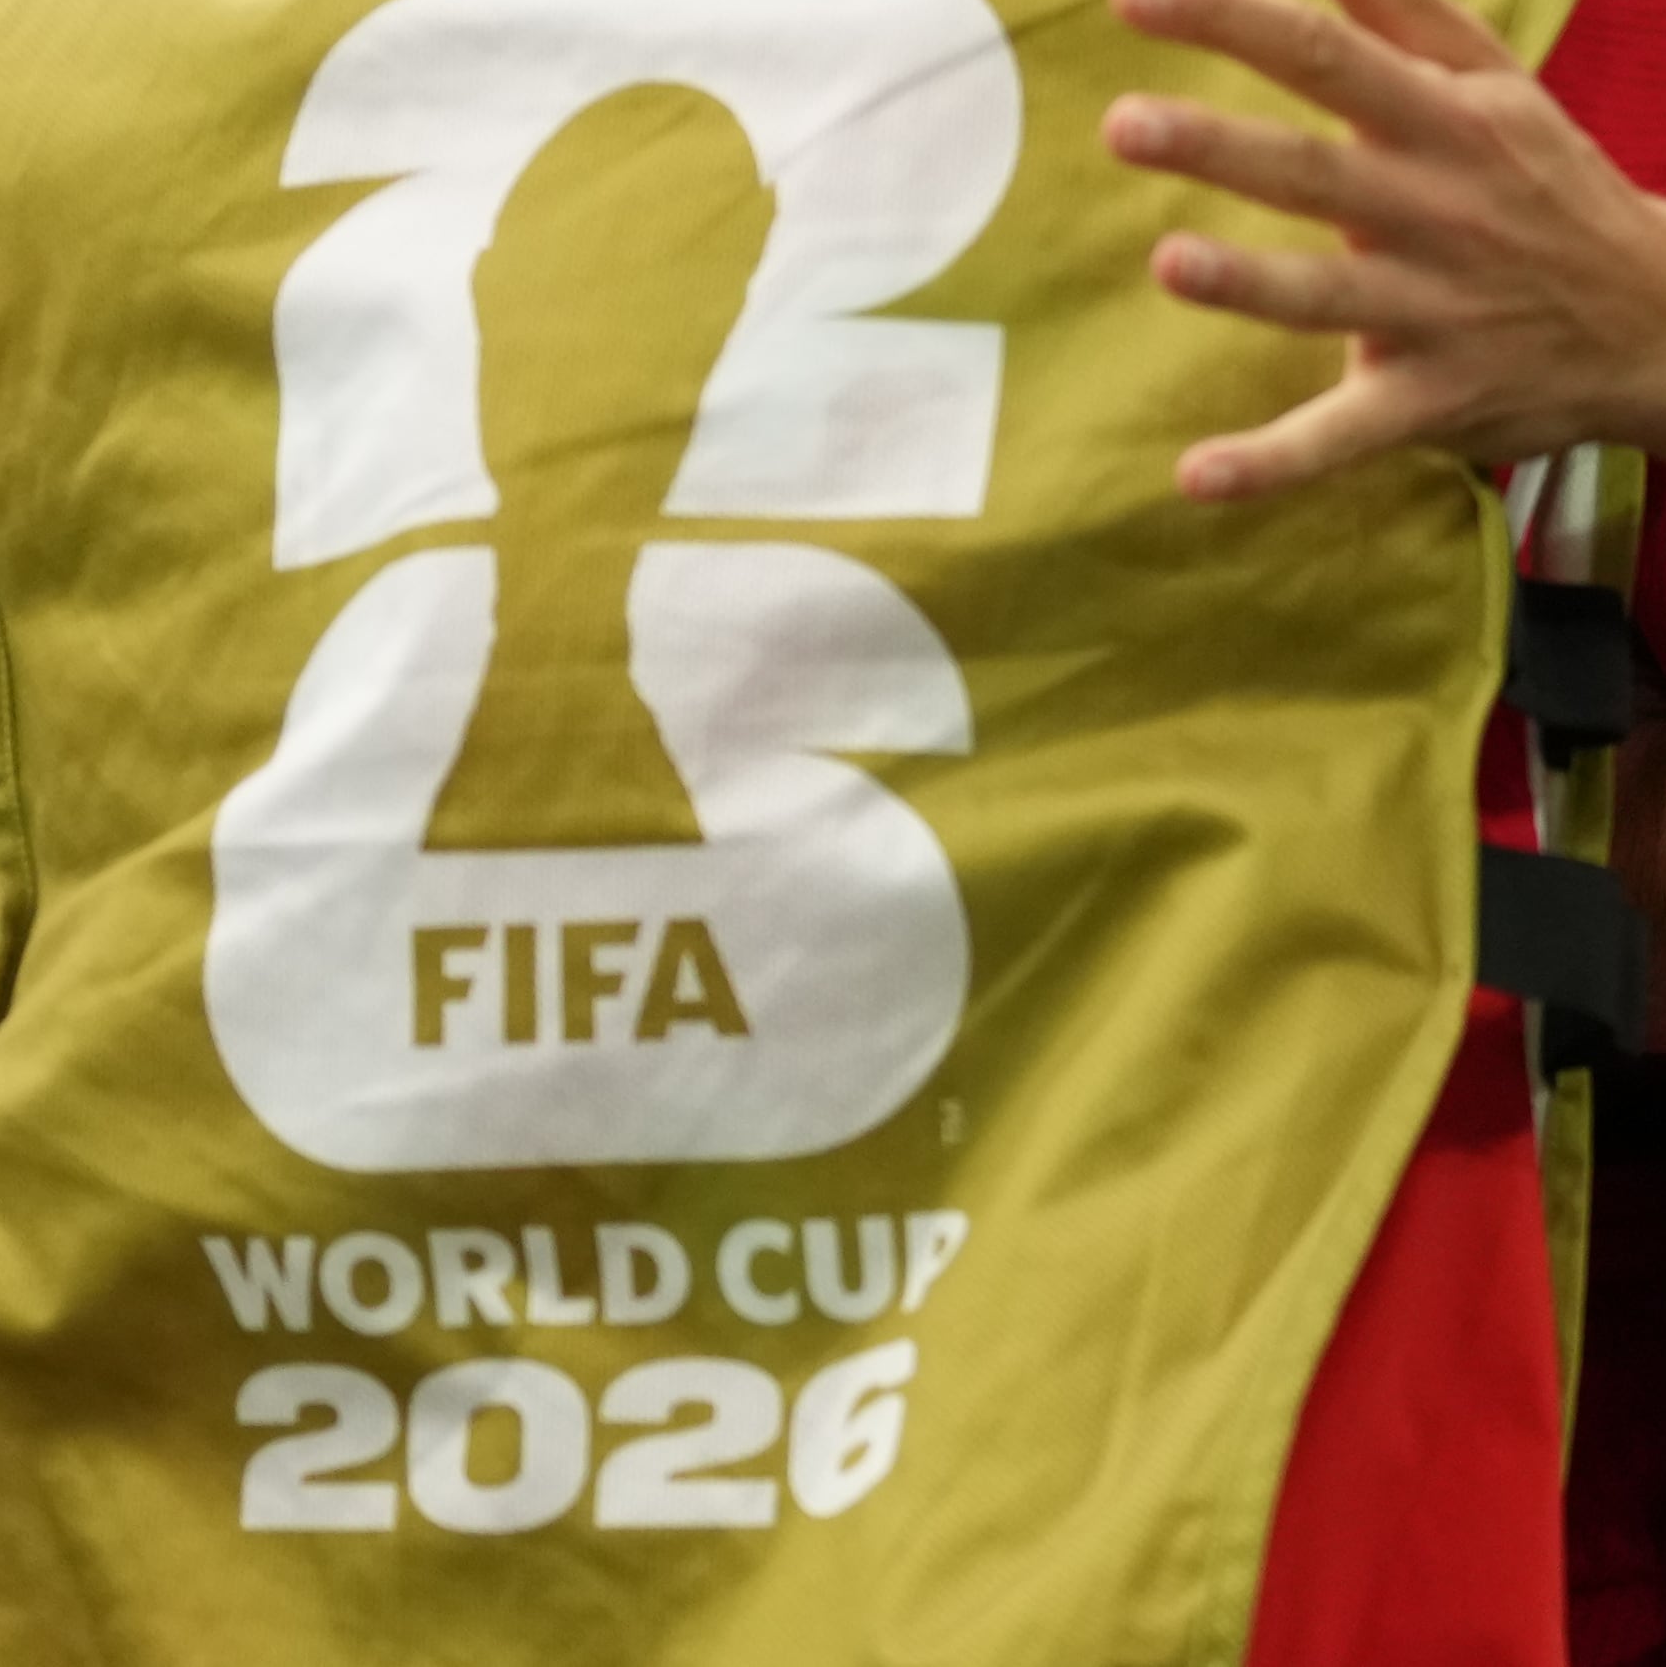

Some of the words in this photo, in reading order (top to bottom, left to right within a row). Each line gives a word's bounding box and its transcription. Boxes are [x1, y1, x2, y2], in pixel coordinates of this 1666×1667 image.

[411, 917, 752, 1047] FIFA
[199, 1221, 693, 1334] WORLD
[716, 1209, 970, 1325] CUP
[235, 1337, 918, 1532] 2026
